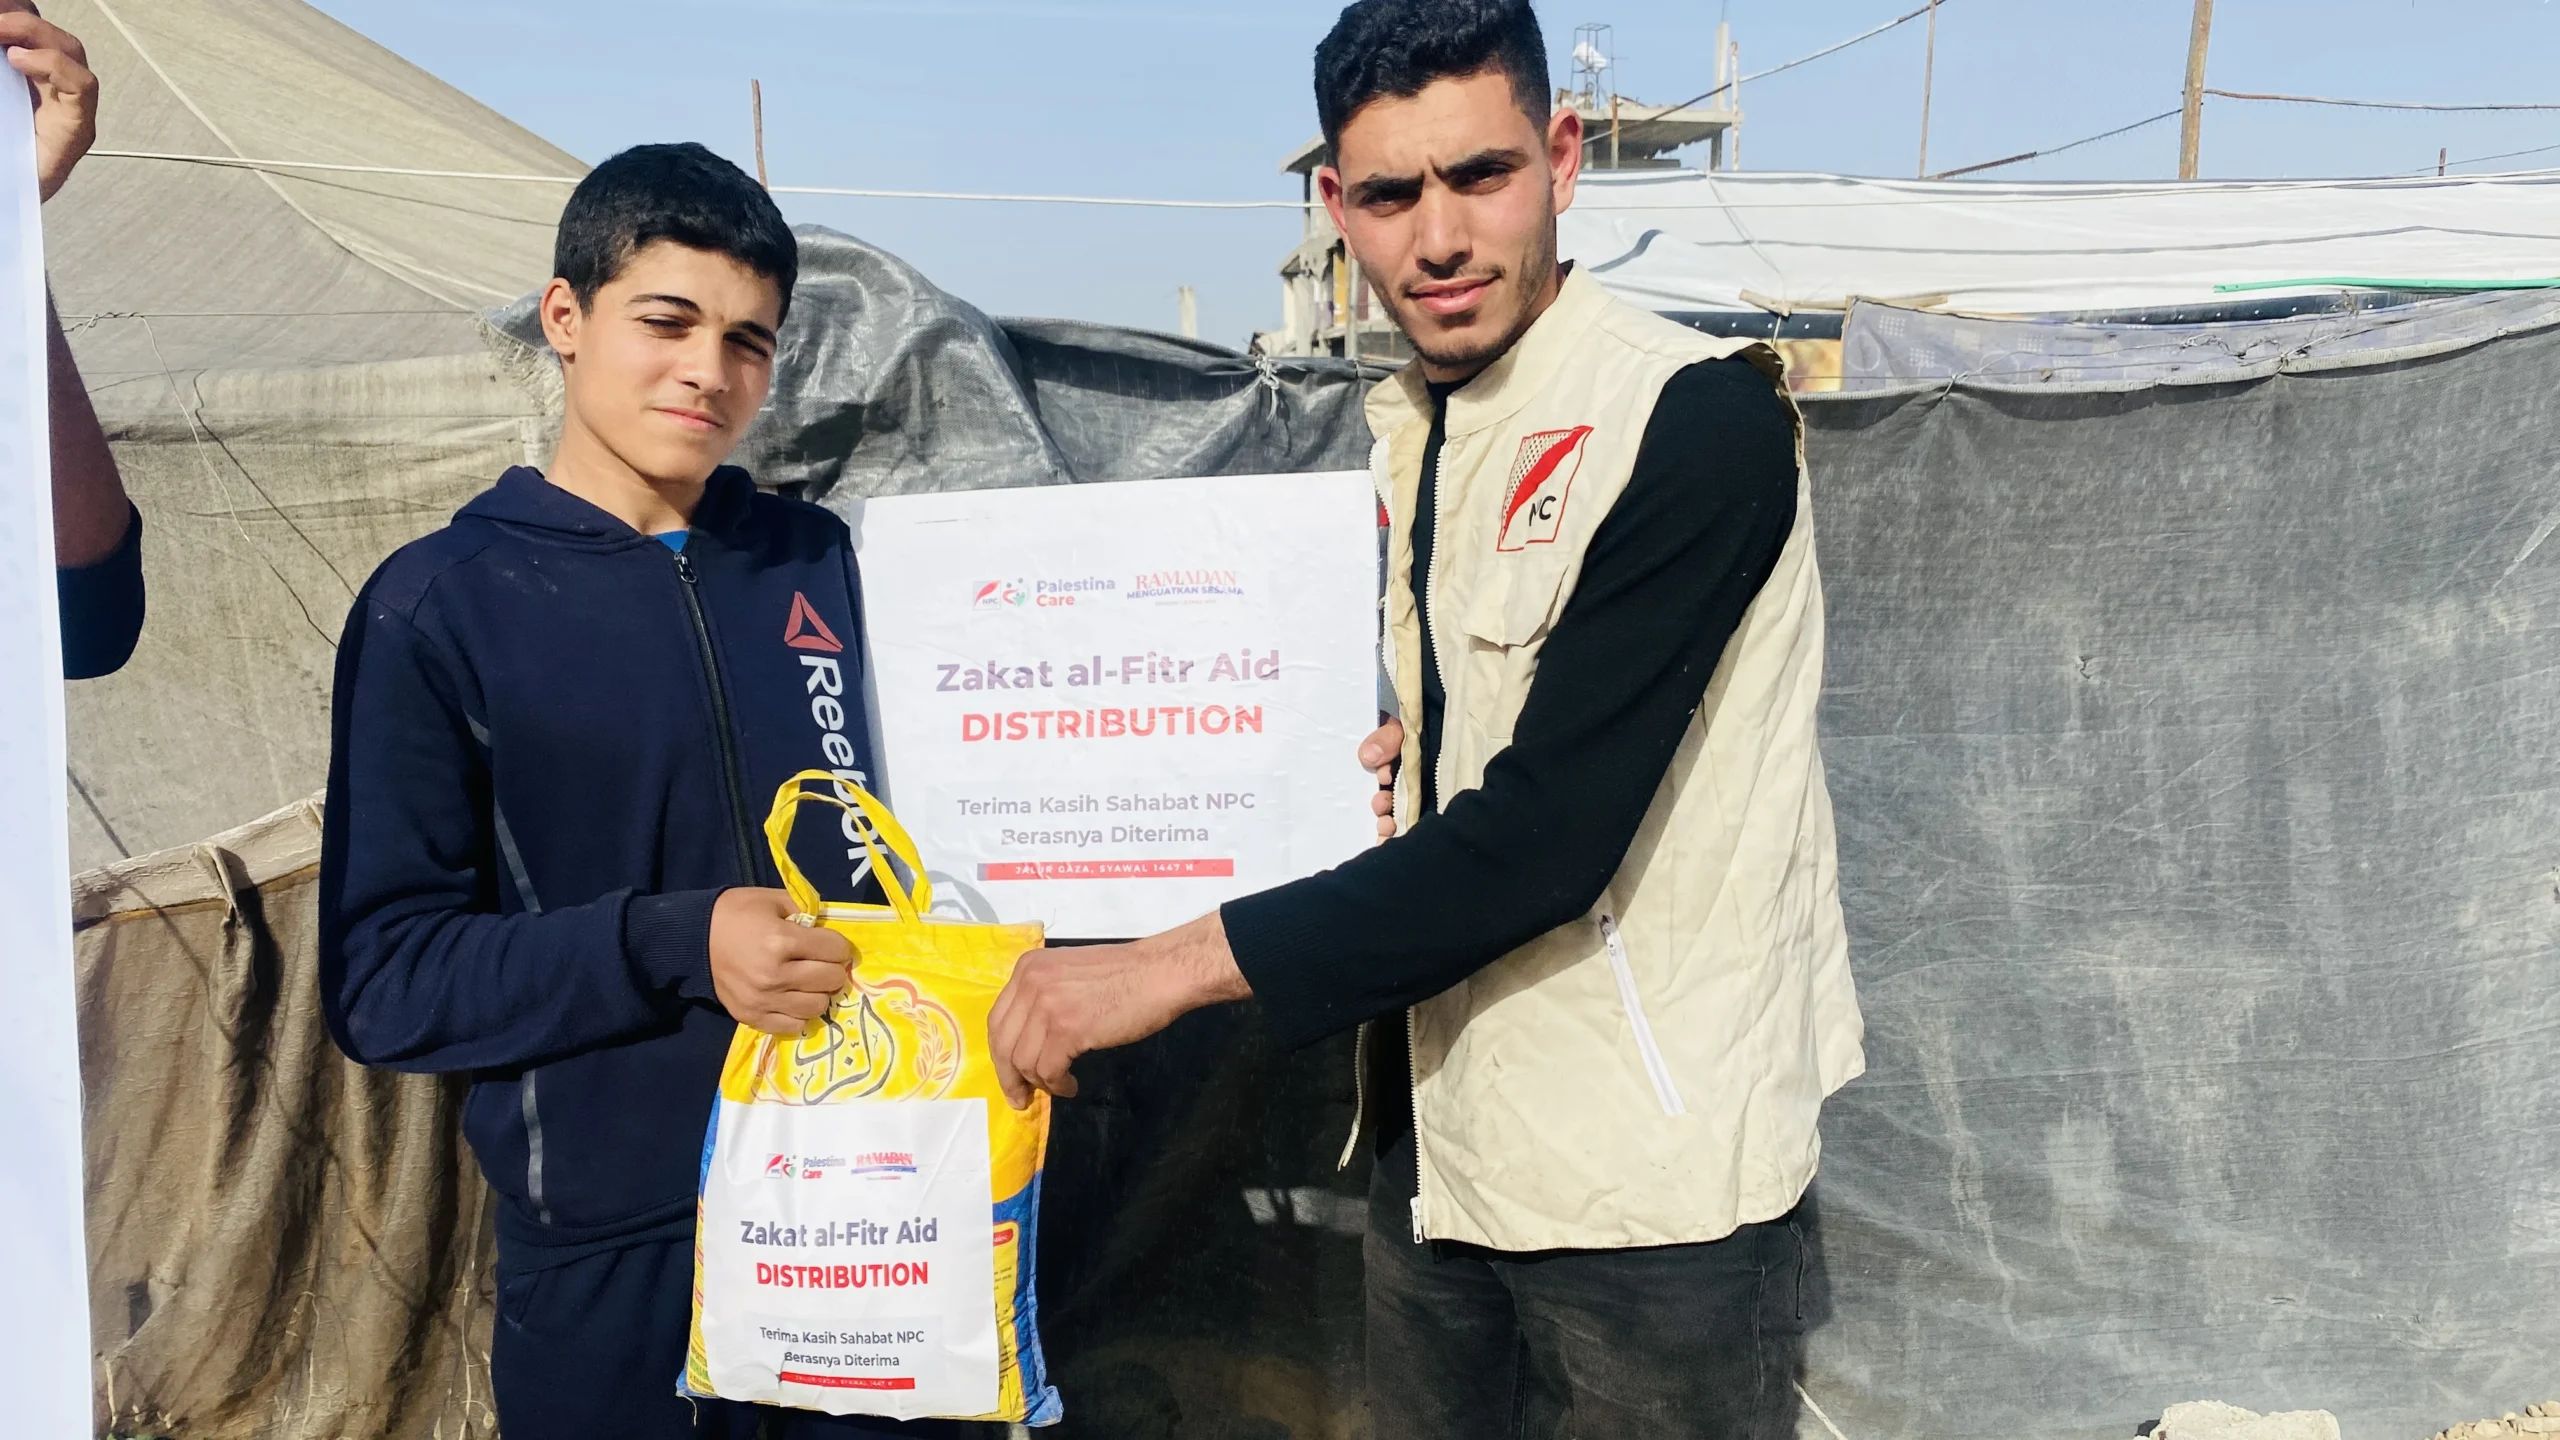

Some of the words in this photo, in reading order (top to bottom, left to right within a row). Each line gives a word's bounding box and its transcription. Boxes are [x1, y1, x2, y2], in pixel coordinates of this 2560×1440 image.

[1036, 576, 1116, 593] Palestina
[1135, 569, 1237, 590] RAMADAN
[1036, 594, 1075, 607] Care
[1126, 586, 1199, 599] MENGUATKAN
[935, 660, 1053, 692] Zakat
[1067, 651, 1194, 687] al-Fitr
[1208, 648, 1280, 682] Aid
[962, 704, 1263, 742] DISTRIBUTION
[799, 655, 888, 888] Reebok
[957, 797, 1031, 815] Terima
[1039, 795, 1099, 813] Kasih
[1106, 793, 1199, 812] Sahabat
[1206, 793, 1256, 810] NPC
[1001, 828, 1103, 848] Berasnya
[1111, 824, 1209, 843] Diterima
[1016, 866, 1053, 875] JALUR
[1100, 864, 1148, 873] SYAWAL
[1153, 863, 1180, 872] 1447
[803, 1155, 846, 1168] Palestina
[802, 1169, 822, 1179] Care
[740, 1220, 807, 1247] Zakat
[814, 1218, 888, 1247] al-Fitr
[896, 1216, 938, 1244] Aid
[756, 1261, 928, 1288] DISTRIBUTION
[759, 1326, 799, 1343] Terima
[802, 1331, 836, 1344] Kasih
[840, 1331, 893, 1344] Sahabat
[897, 1331, 925, 1343] NPC
[784, 1351, 840, 1368] Berasnya
[844, 1354, 900, 1366] Diterima
